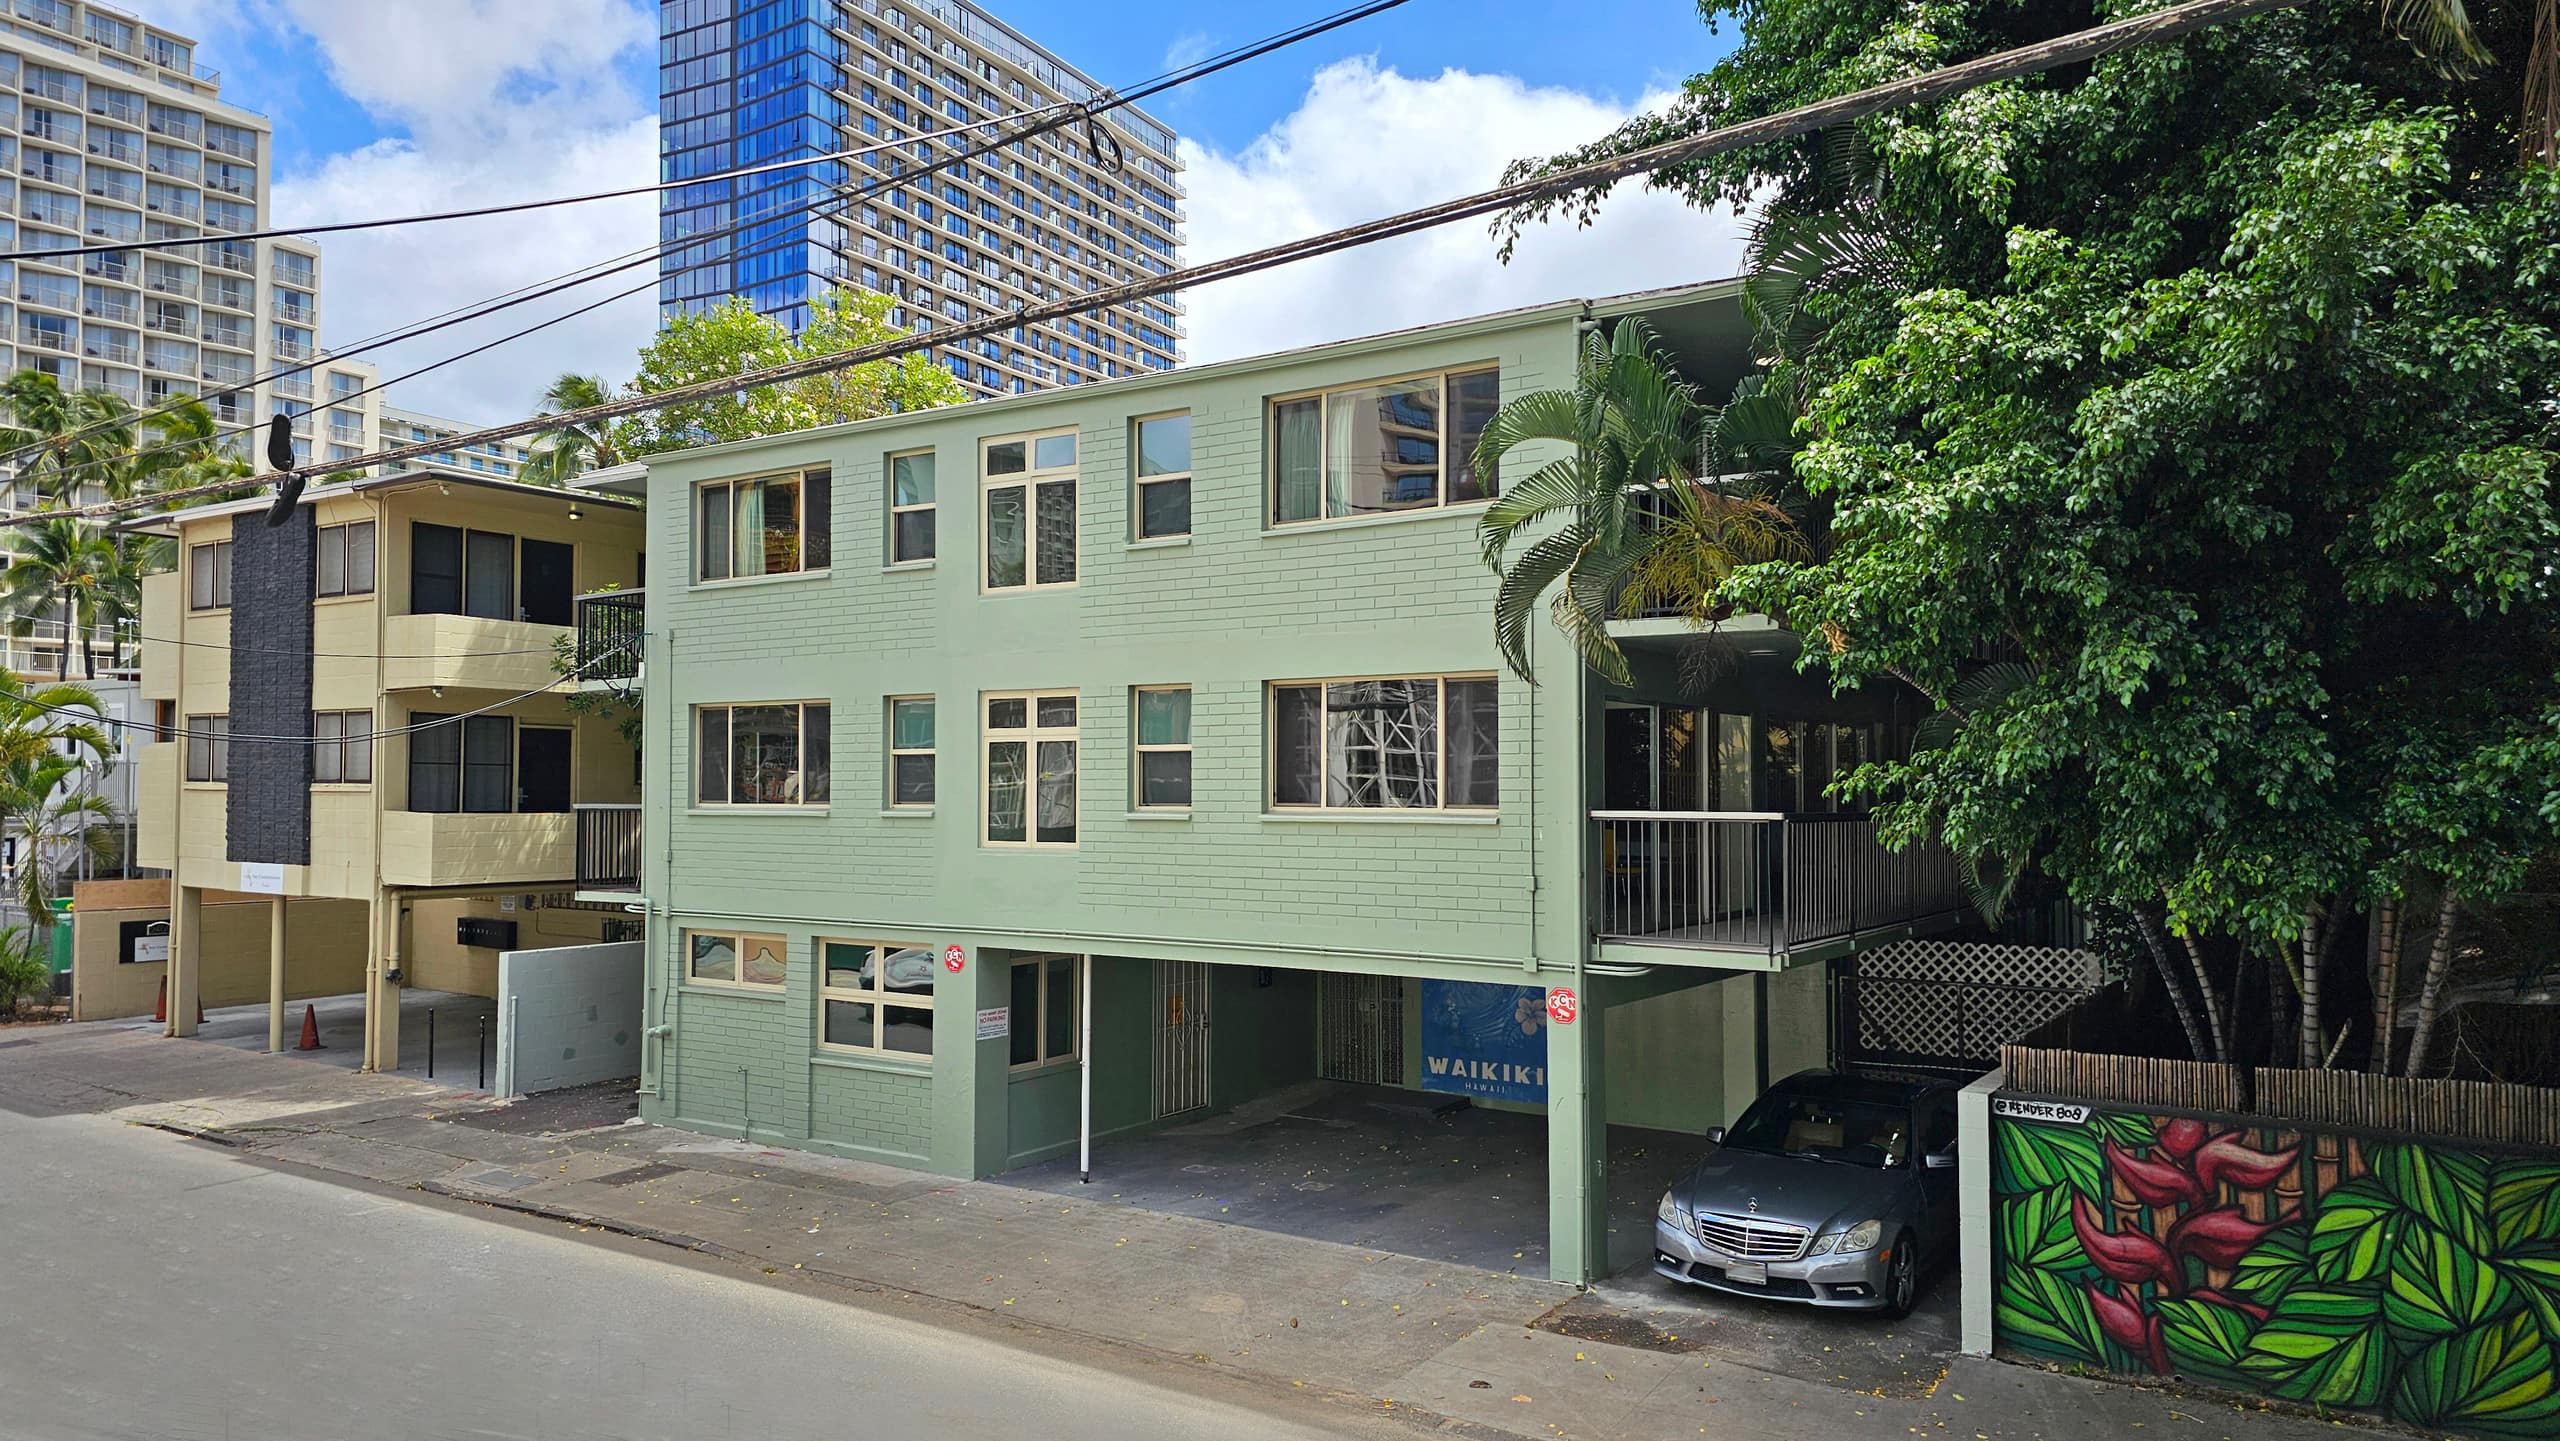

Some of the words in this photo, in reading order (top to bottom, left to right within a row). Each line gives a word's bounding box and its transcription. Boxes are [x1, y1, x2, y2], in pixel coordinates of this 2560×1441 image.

[1550, 994, 1576, 1009] KCN
[1428, 1056, 1544, 1086] WAIKIKI
[1465, 1082, 1505, 1094] HAWAII
[2056, 1107, 2082, 1120] 808
